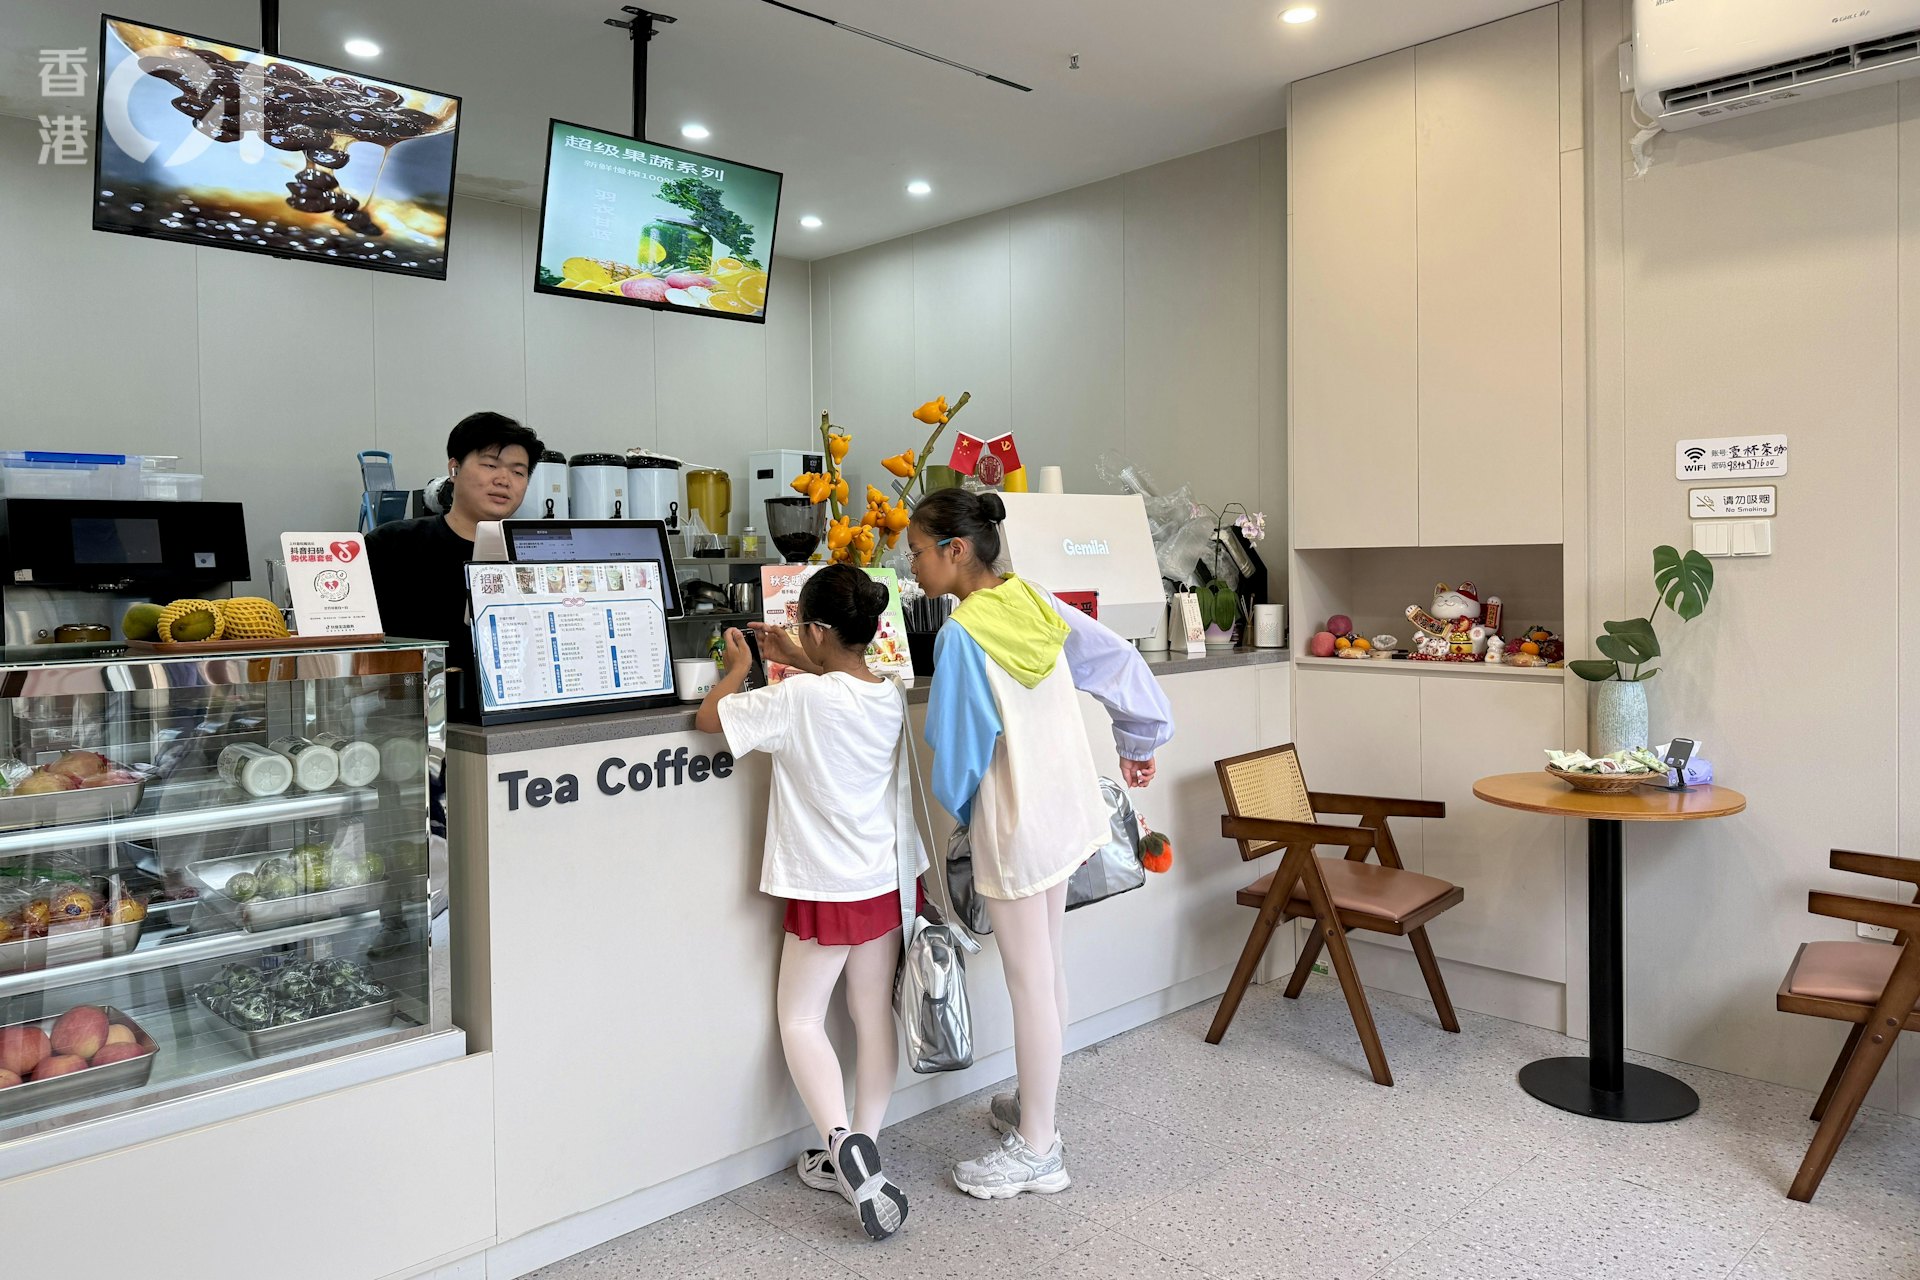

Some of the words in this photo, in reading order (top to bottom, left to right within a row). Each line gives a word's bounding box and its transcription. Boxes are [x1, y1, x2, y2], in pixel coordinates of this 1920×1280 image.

[564, 135, 725, 182] 超级果蔬系列
[592, 188, 617, 241] 羽衣甘蓝
[1723, 494, 1770, 505] 请勿吸烟
[290, 547, 325, 555] 抖音扫码
[1063, 539, 1110, 556] Gemilai
[291, 554, 334, 563] 购优惠套餐
[480, 573, 504, 584] 招牌
[481, 583, 505, 594] 必喝
[498, 769, 579, 811] Tea
[597, 746, 734, 796] Coffee
